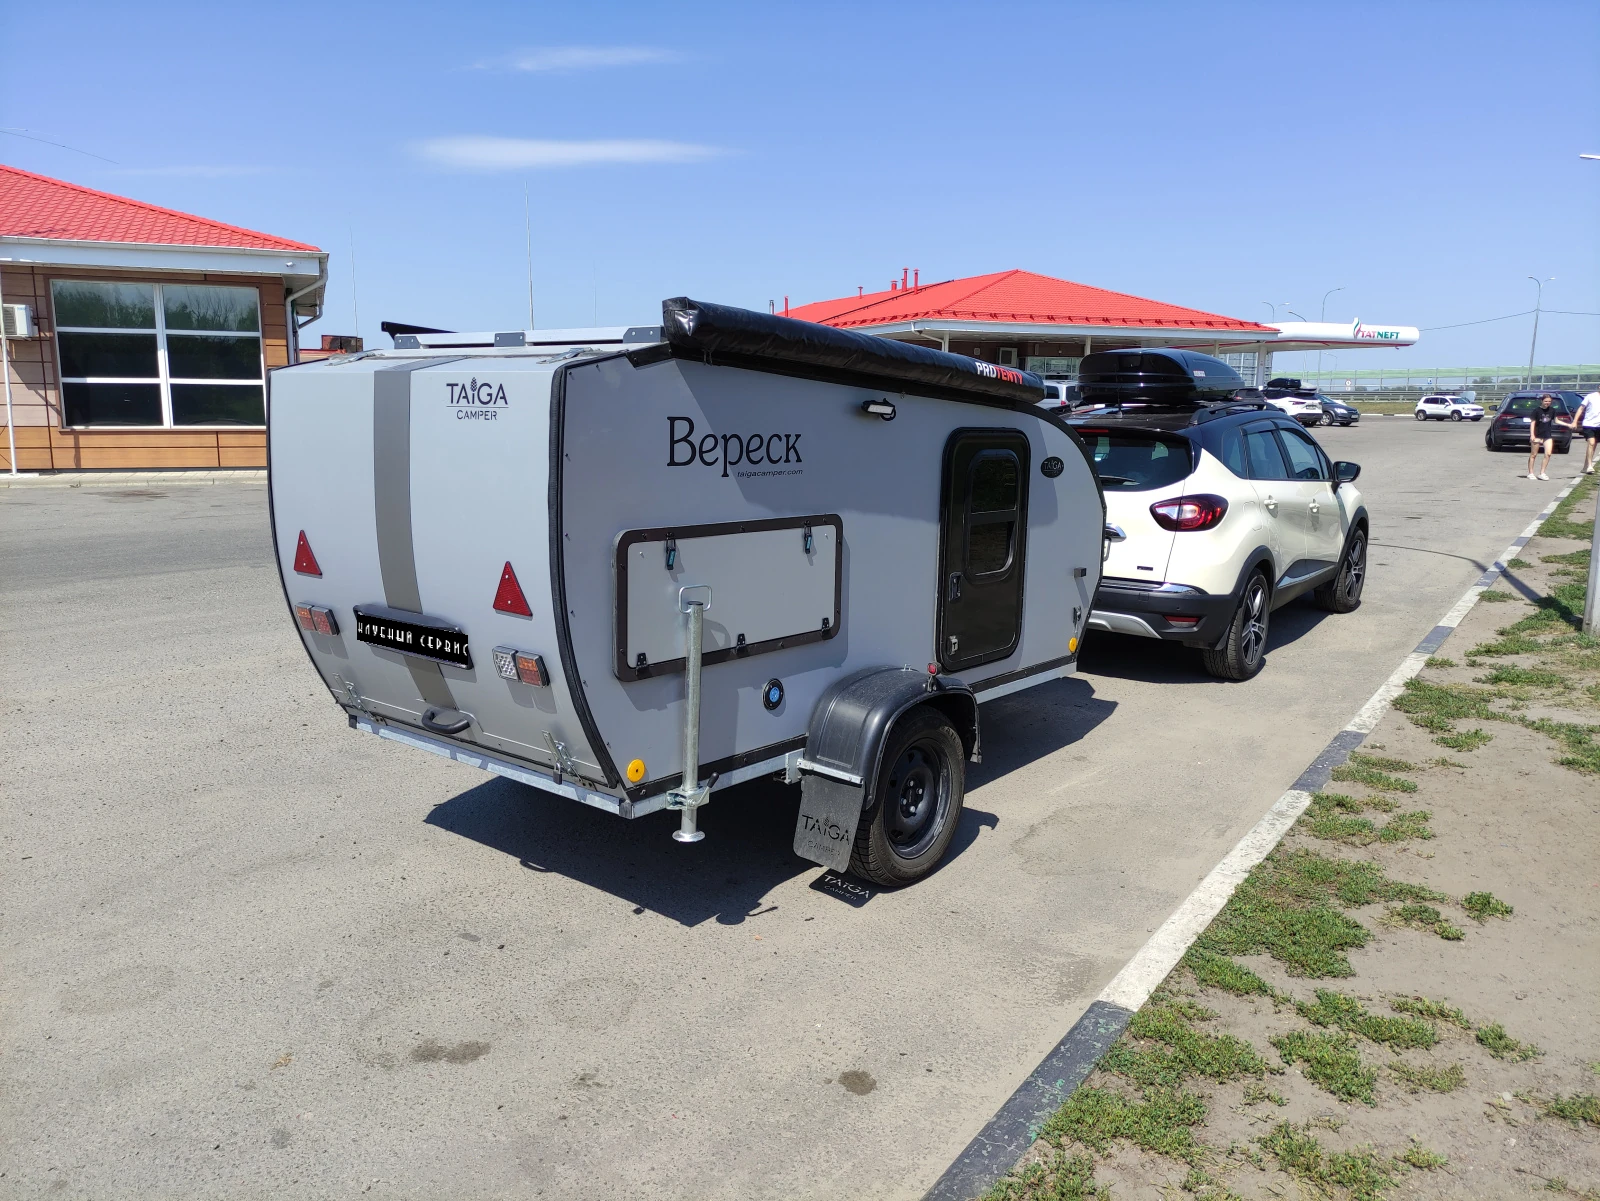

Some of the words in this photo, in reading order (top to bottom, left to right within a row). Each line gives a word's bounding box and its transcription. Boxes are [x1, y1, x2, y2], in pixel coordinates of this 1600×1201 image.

[1361, 331, 1400, 339] TATNEFT
[456, 410, 498, 420] CAMPER
[667, 416, 803, 478] Вереск
[737, 469, 803, 478] taigacamper.com
